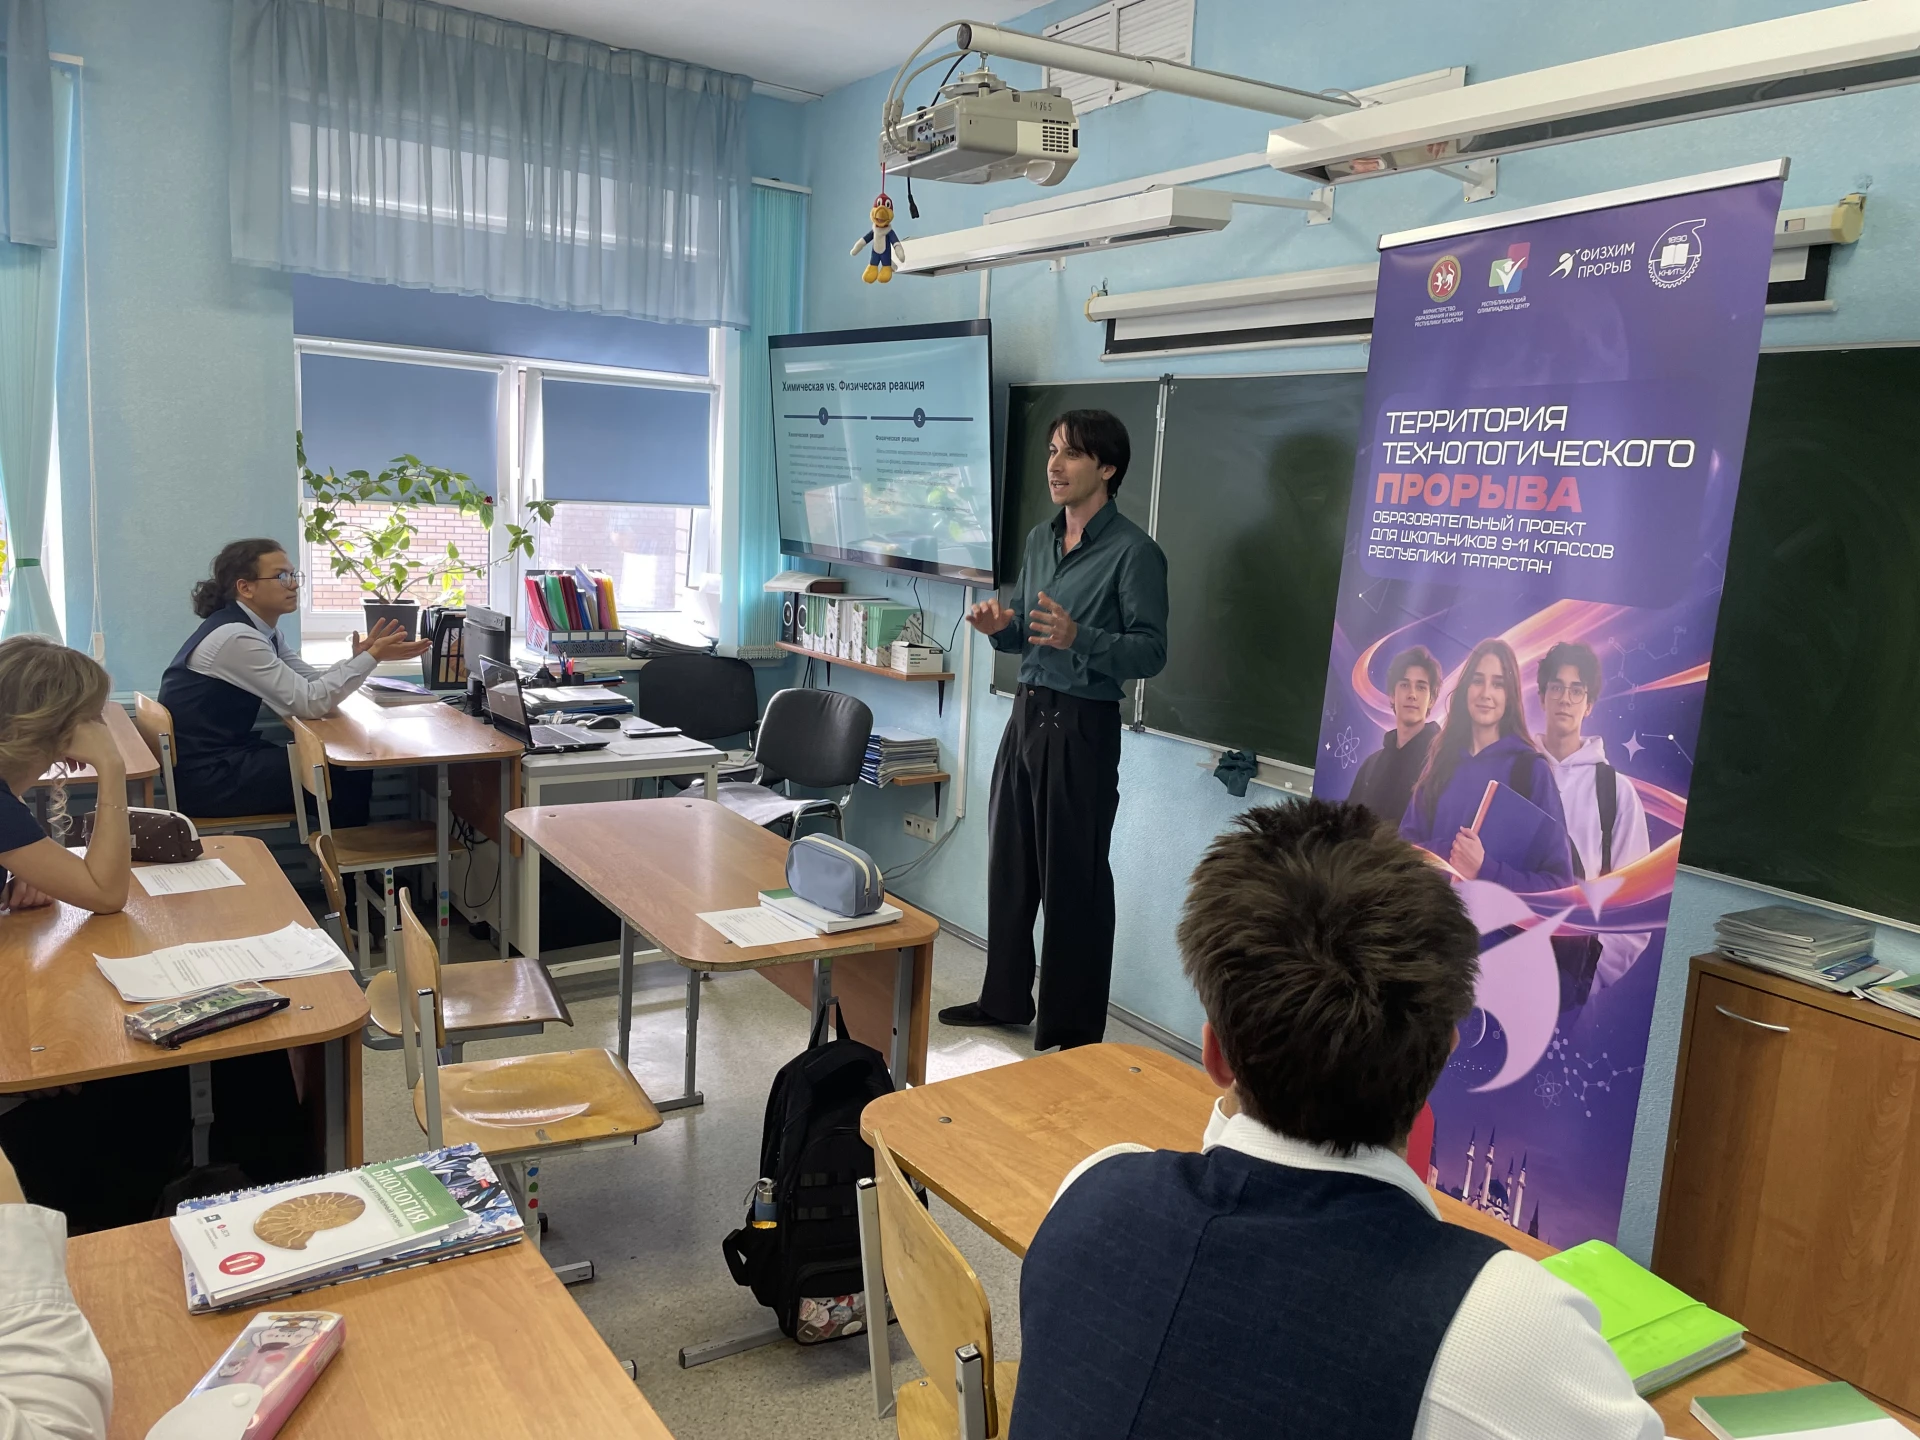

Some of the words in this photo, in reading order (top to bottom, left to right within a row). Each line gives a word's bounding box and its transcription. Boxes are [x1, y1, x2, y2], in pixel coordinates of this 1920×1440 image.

[1580, 242, 1635, 262] ФИЗХИМ
[1577, 259, 1632, 278] ПРОРЫВ
[1659, 267, 1687, 276] КНИТУ
[1514, 302, 1530, 310] ЦЕНТР
[782, 381, 824, 392] Химическая
[826, 382, 837, 391] vs.
[839, 380, 886, 391] Физическая
[889, 380, 925, 393] реакция
[1386, 405, 1568, 434] ТЕРРИТОРИЯ
[1382, 439, 1696, 468] ТЕХНОЛОГИЧЕСКОГО
[1375, 472, 1583, 513] ПРОРЫВА
[1372, 510, 1514, 532] ОБРАЗОВАТЕЛЬНЫЙ
[1518, 518, 1586, 536] ПРОЕКТ
[1370, 527, 1398, 542] ДЛЯ
[1400, 530, 1498, 550] ШКОЛЬНИКОВ
[1501, 537, 1529, 552] 9-11
[1534, 539, 1614, 559] КЛАССОВ
[1368, 544, 1456, 565] РЕСПУБЛИКИ
[1461, 552, 1552, 574] ТАТАРСТАН
[371, 1168, 430, 1224] БИОЛОГИЯ
[226, 1255, 258, 1272] 11
